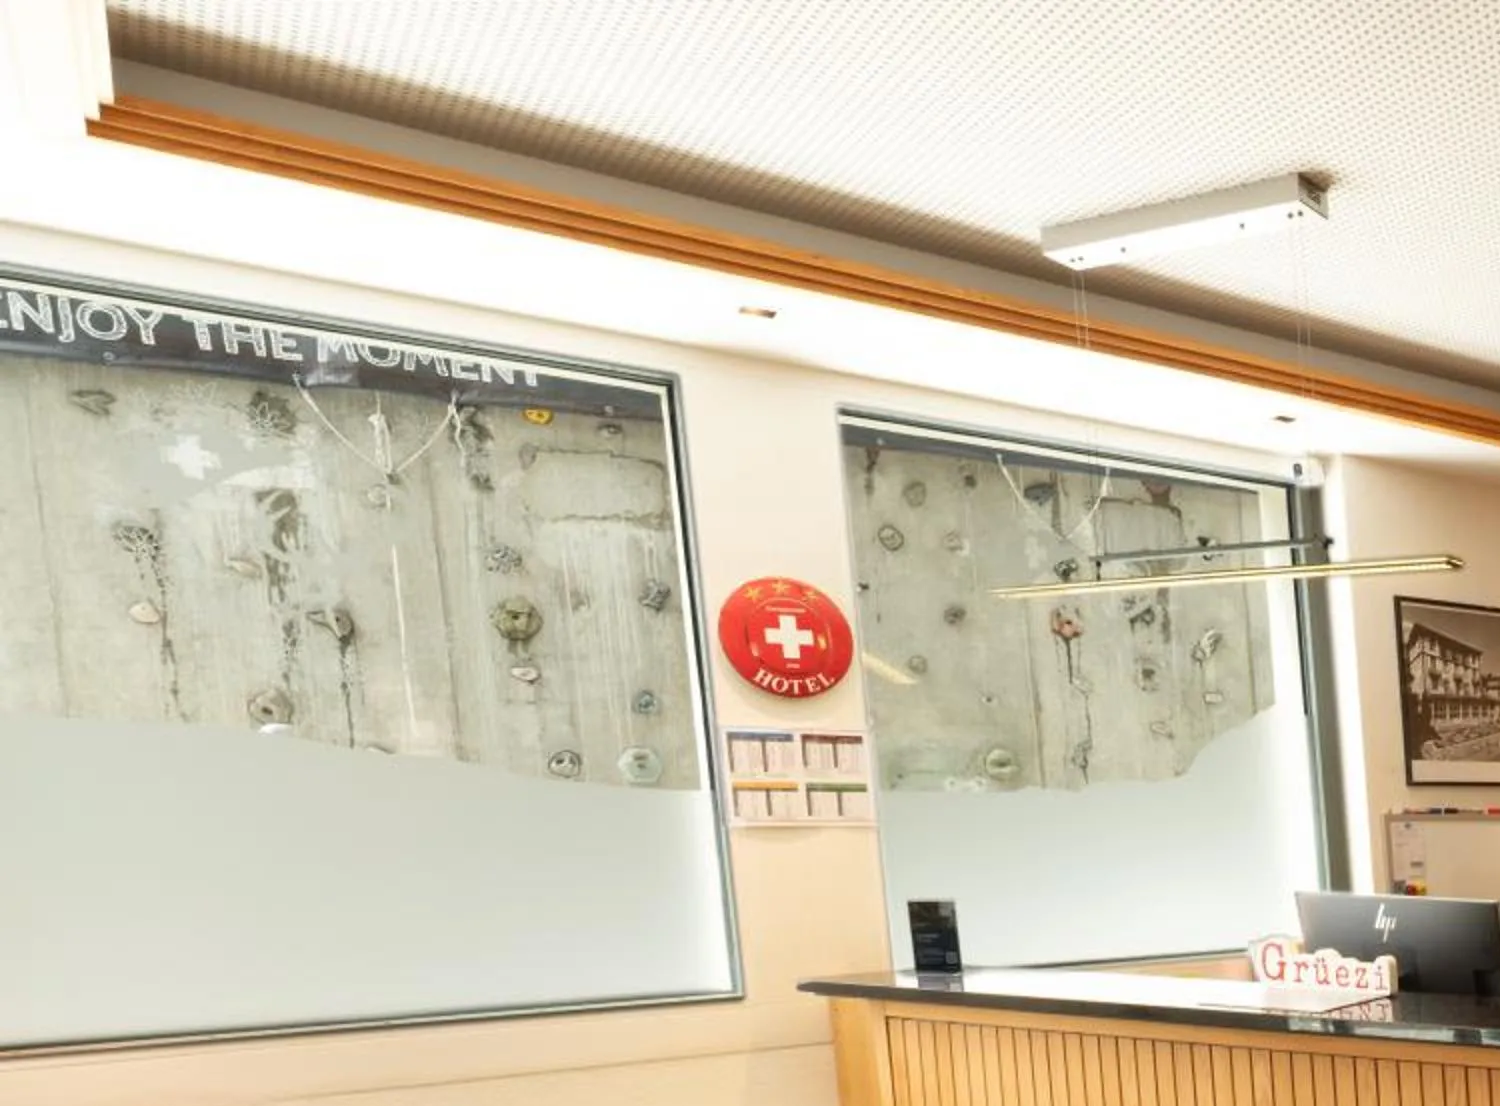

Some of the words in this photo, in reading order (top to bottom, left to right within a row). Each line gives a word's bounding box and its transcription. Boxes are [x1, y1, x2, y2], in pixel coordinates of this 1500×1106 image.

[183, 317, 302, 361] THE
[753, 667, 835, 695] HOTEL
[1261, 942, 1388, 991] Grüezi
